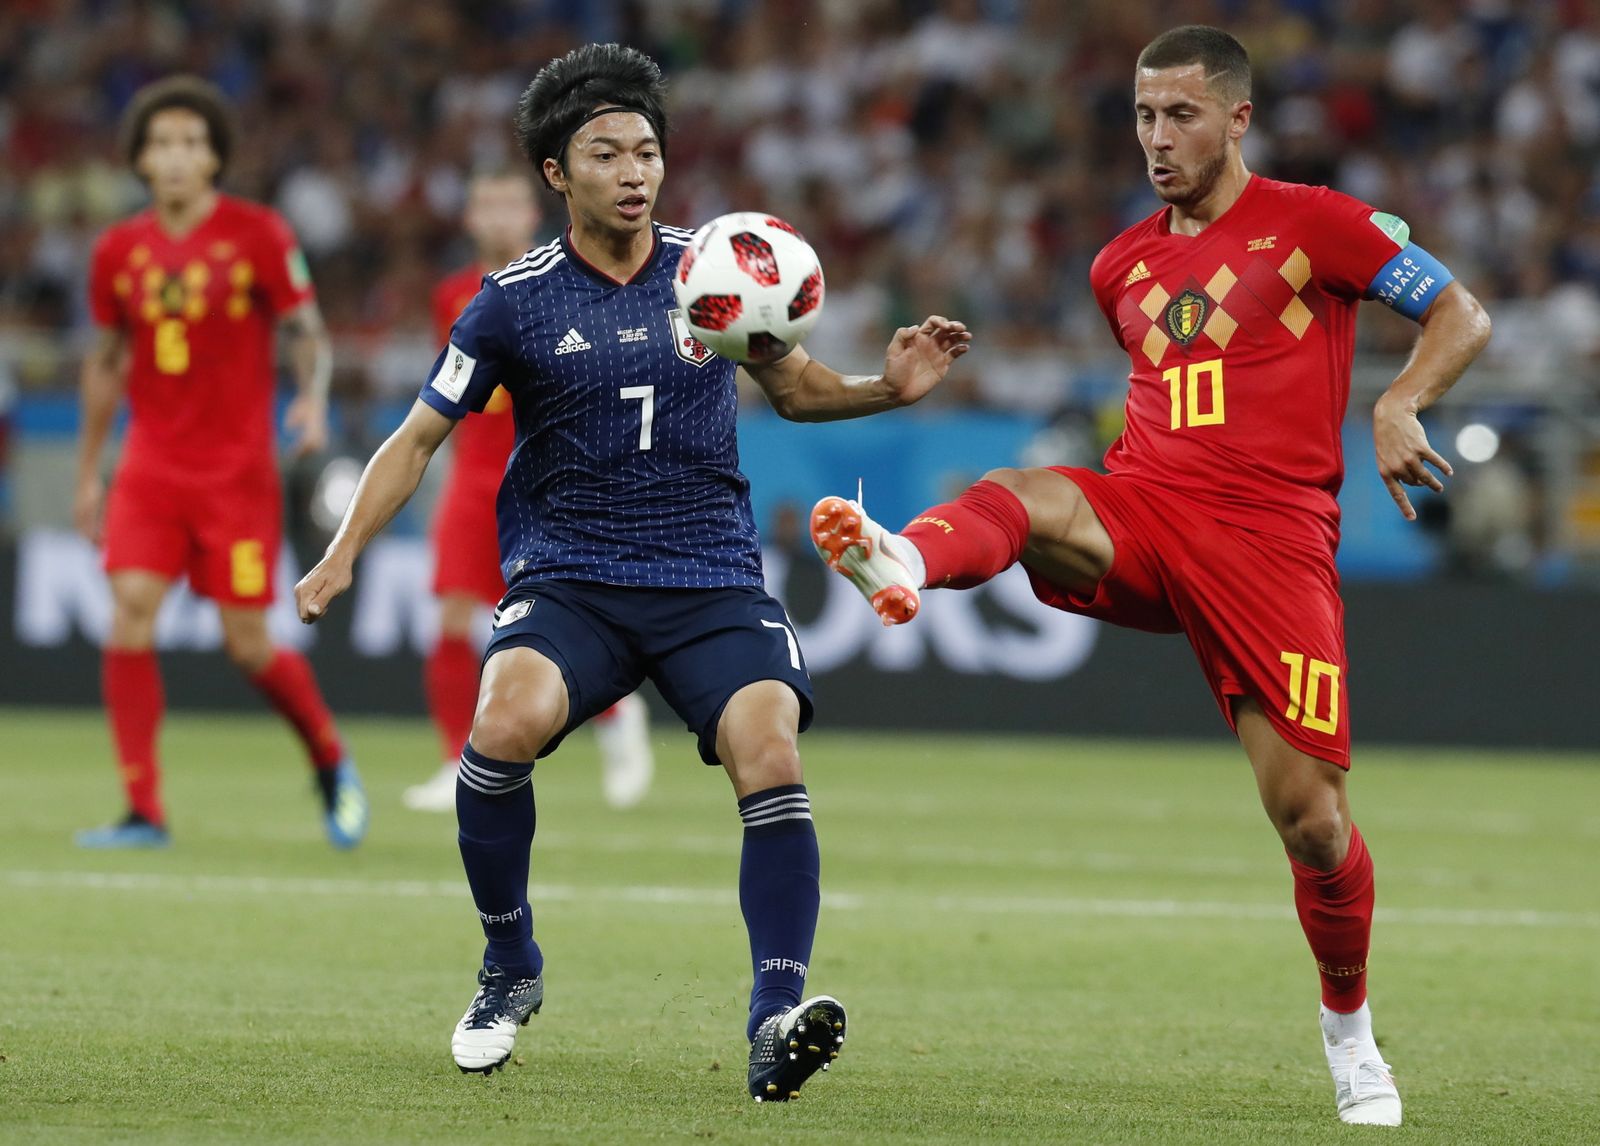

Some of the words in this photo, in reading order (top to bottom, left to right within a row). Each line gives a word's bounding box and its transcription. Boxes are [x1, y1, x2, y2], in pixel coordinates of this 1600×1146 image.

[1378, 257, 1413, 298] VING
[1385, 265, 1421, 306] OTBALL
[1410, 275, 1435, 301] FIFA
[554, 342, 591, 355] adidas
[1162, 358, 1225, 431] 10
[619, 384, 654, 450] 7
[760, 619, 801, 671] 7
[1280, 650, 1340, 736] 10
[479, 906, 523, 924] APAN
[760, 958, 808, 980] JAPAN
